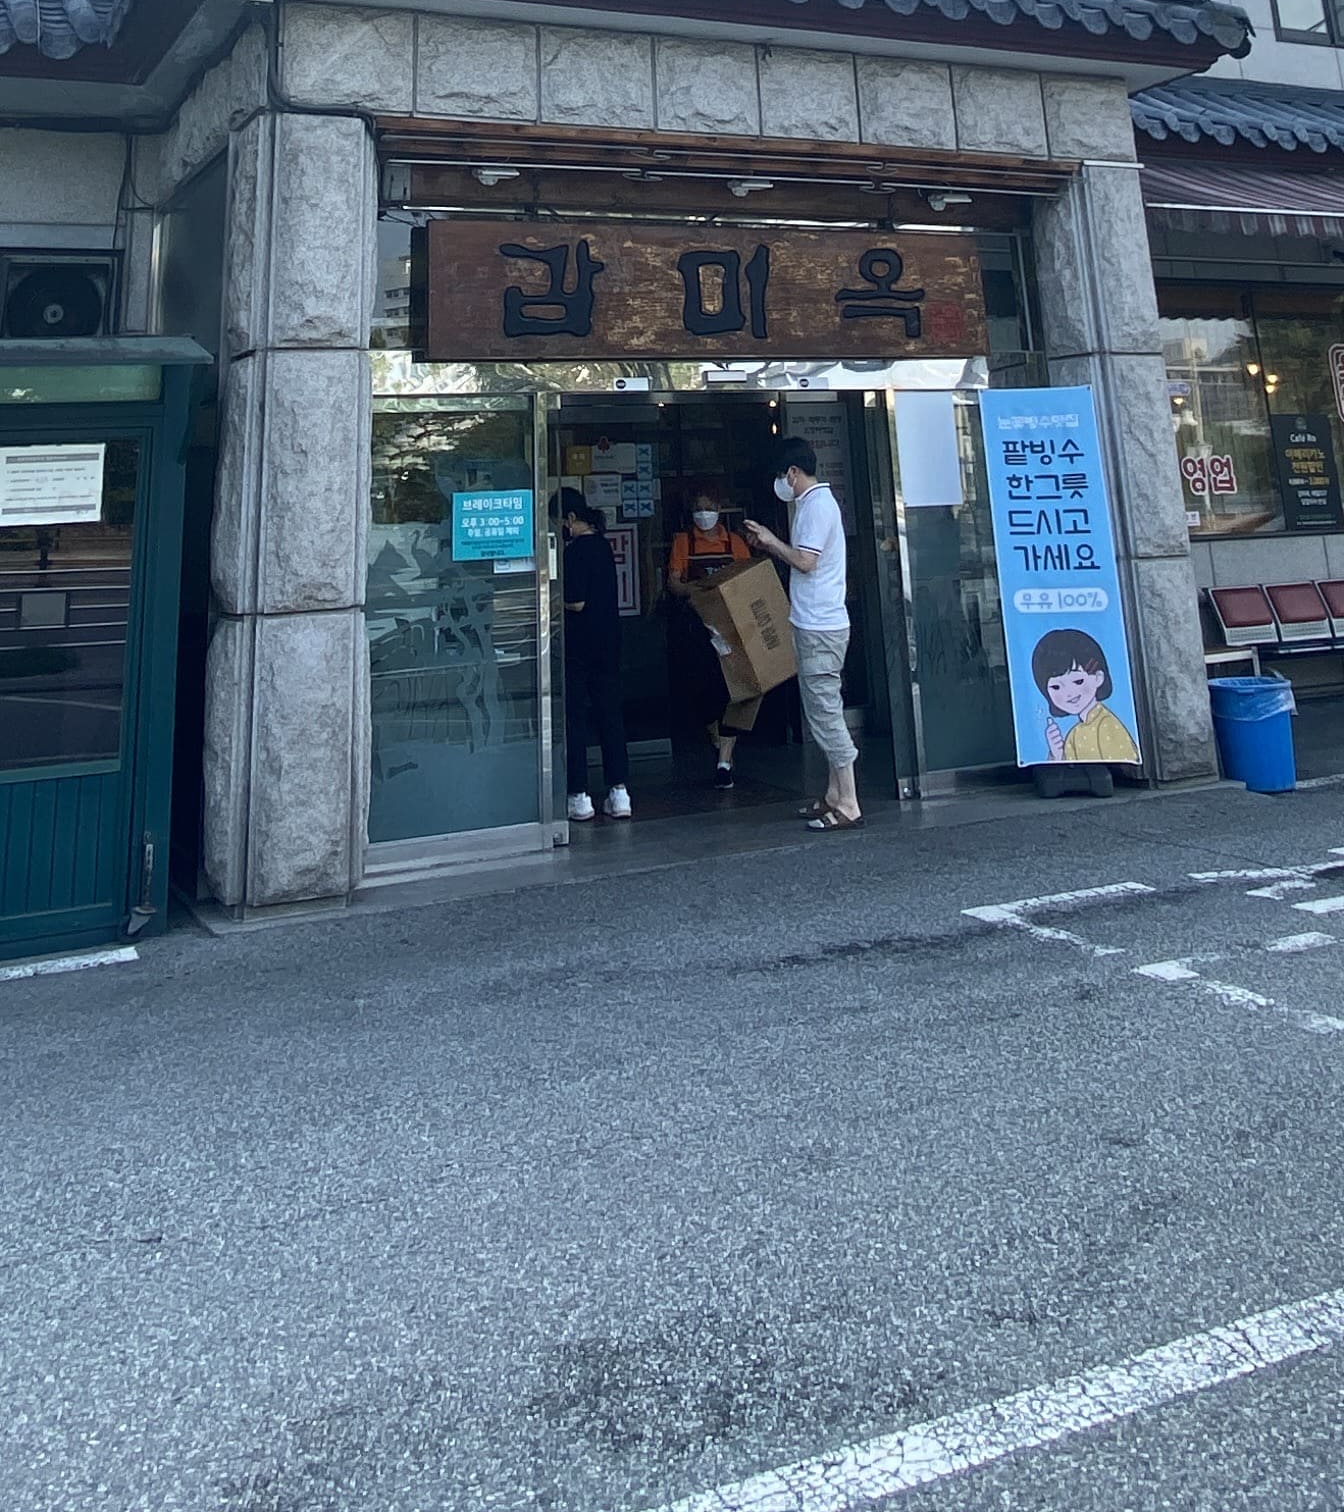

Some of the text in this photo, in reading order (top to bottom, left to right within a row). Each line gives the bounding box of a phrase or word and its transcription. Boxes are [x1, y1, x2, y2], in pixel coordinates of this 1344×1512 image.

[498, 238, 926, 340] 감미옥
[1002, 438, 1085, 466] 팥빙수
[1006, 473, 1089, 501] 한그릇
[1182, 454, 1237, 495] 영업
[462, 496, 523, 511] 브레이크타임
[1008, 508, 1092, 536] 드시고
[1013, 543, 1101, 572] 가세요
[1019, 591, 1103, 610] 우유 100%
